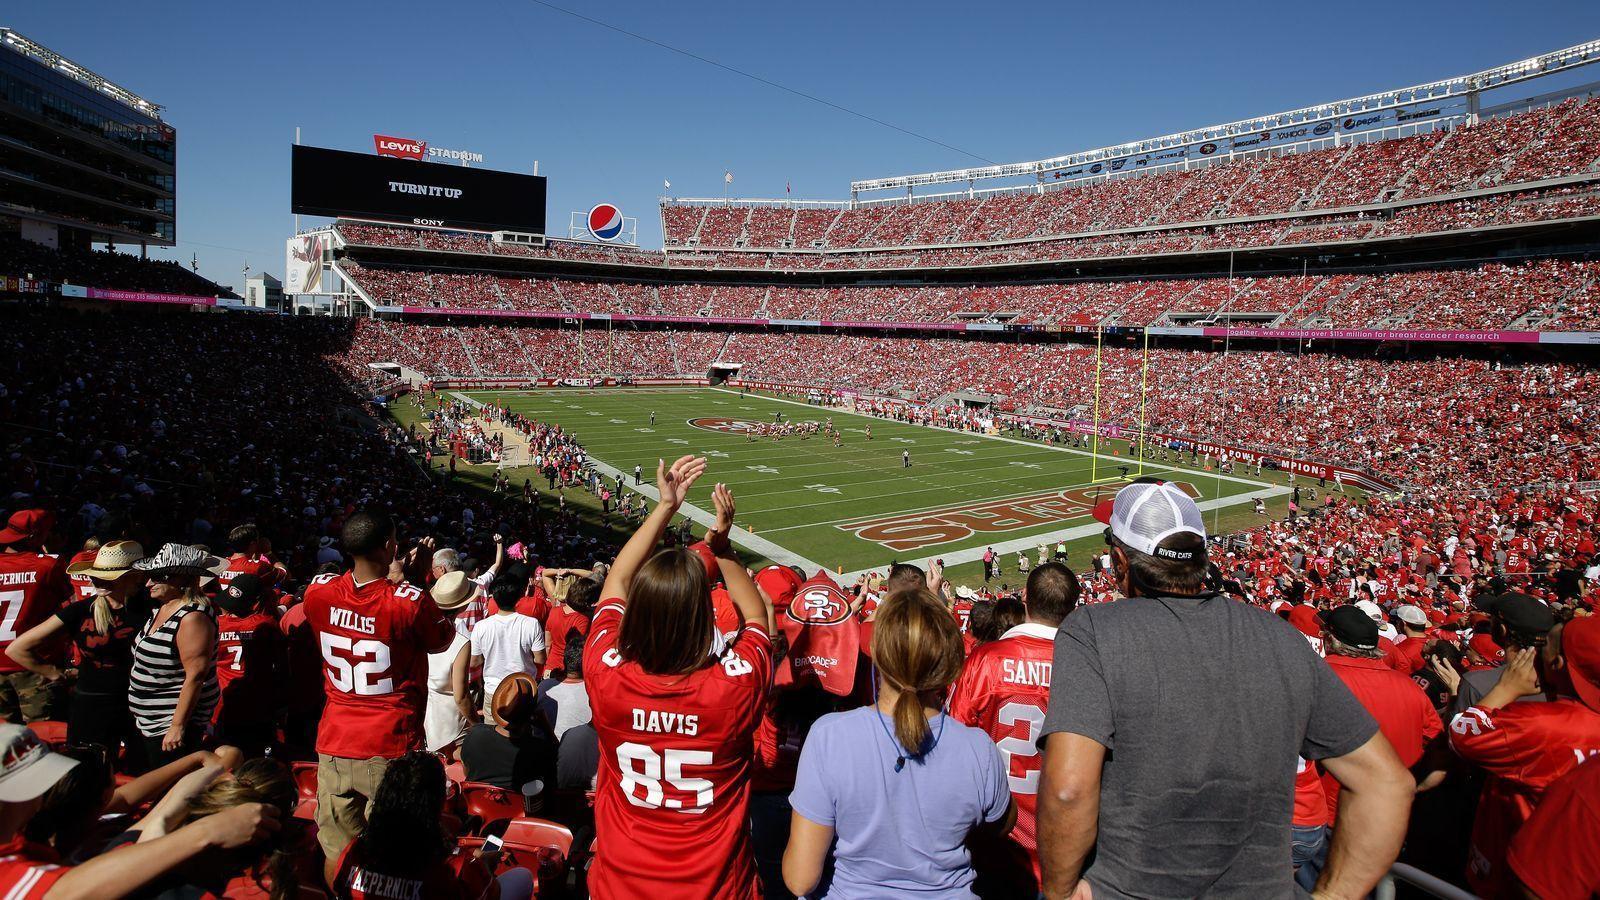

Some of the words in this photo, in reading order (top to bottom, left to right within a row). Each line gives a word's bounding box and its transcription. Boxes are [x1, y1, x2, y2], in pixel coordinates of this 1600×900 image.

[1356, 115, 1382, 127] pepsi
[428, 147, 483, 162] STADIUM
[388, 181, 427, 196] TURN
[428, 185, 444, 197] IT
[444, 188, 463, 199] UP
[413, 217, 445, 227] SONY
[1286, 329, 1308, 338] raised
[1346, 331, 1373, 339] million
[1375, 331, 1388, 339] for
[1389, 331, 1417, 340] breast
[1419, 333, 1452, 341] cancer
[1454, 332, 1500, 341] research
[1229, 449, 1256, 462] BOWL
[1158, 547, 1177, 558] RIVER
[1177, 551, 1193, 560] CATS
[0, 590, 25, 641] 7
[329, 606, 376, 635] WILLIS
[227, 645, 244, 671] 7
[319, 630, 394, 695] 52
[1003, 658, 1052, 687] SAND
[632, 708, 699, 736] DAVIS
[615, 741, 714, 814] 85
[349, 865, 424, 900] KAEPERNICK
